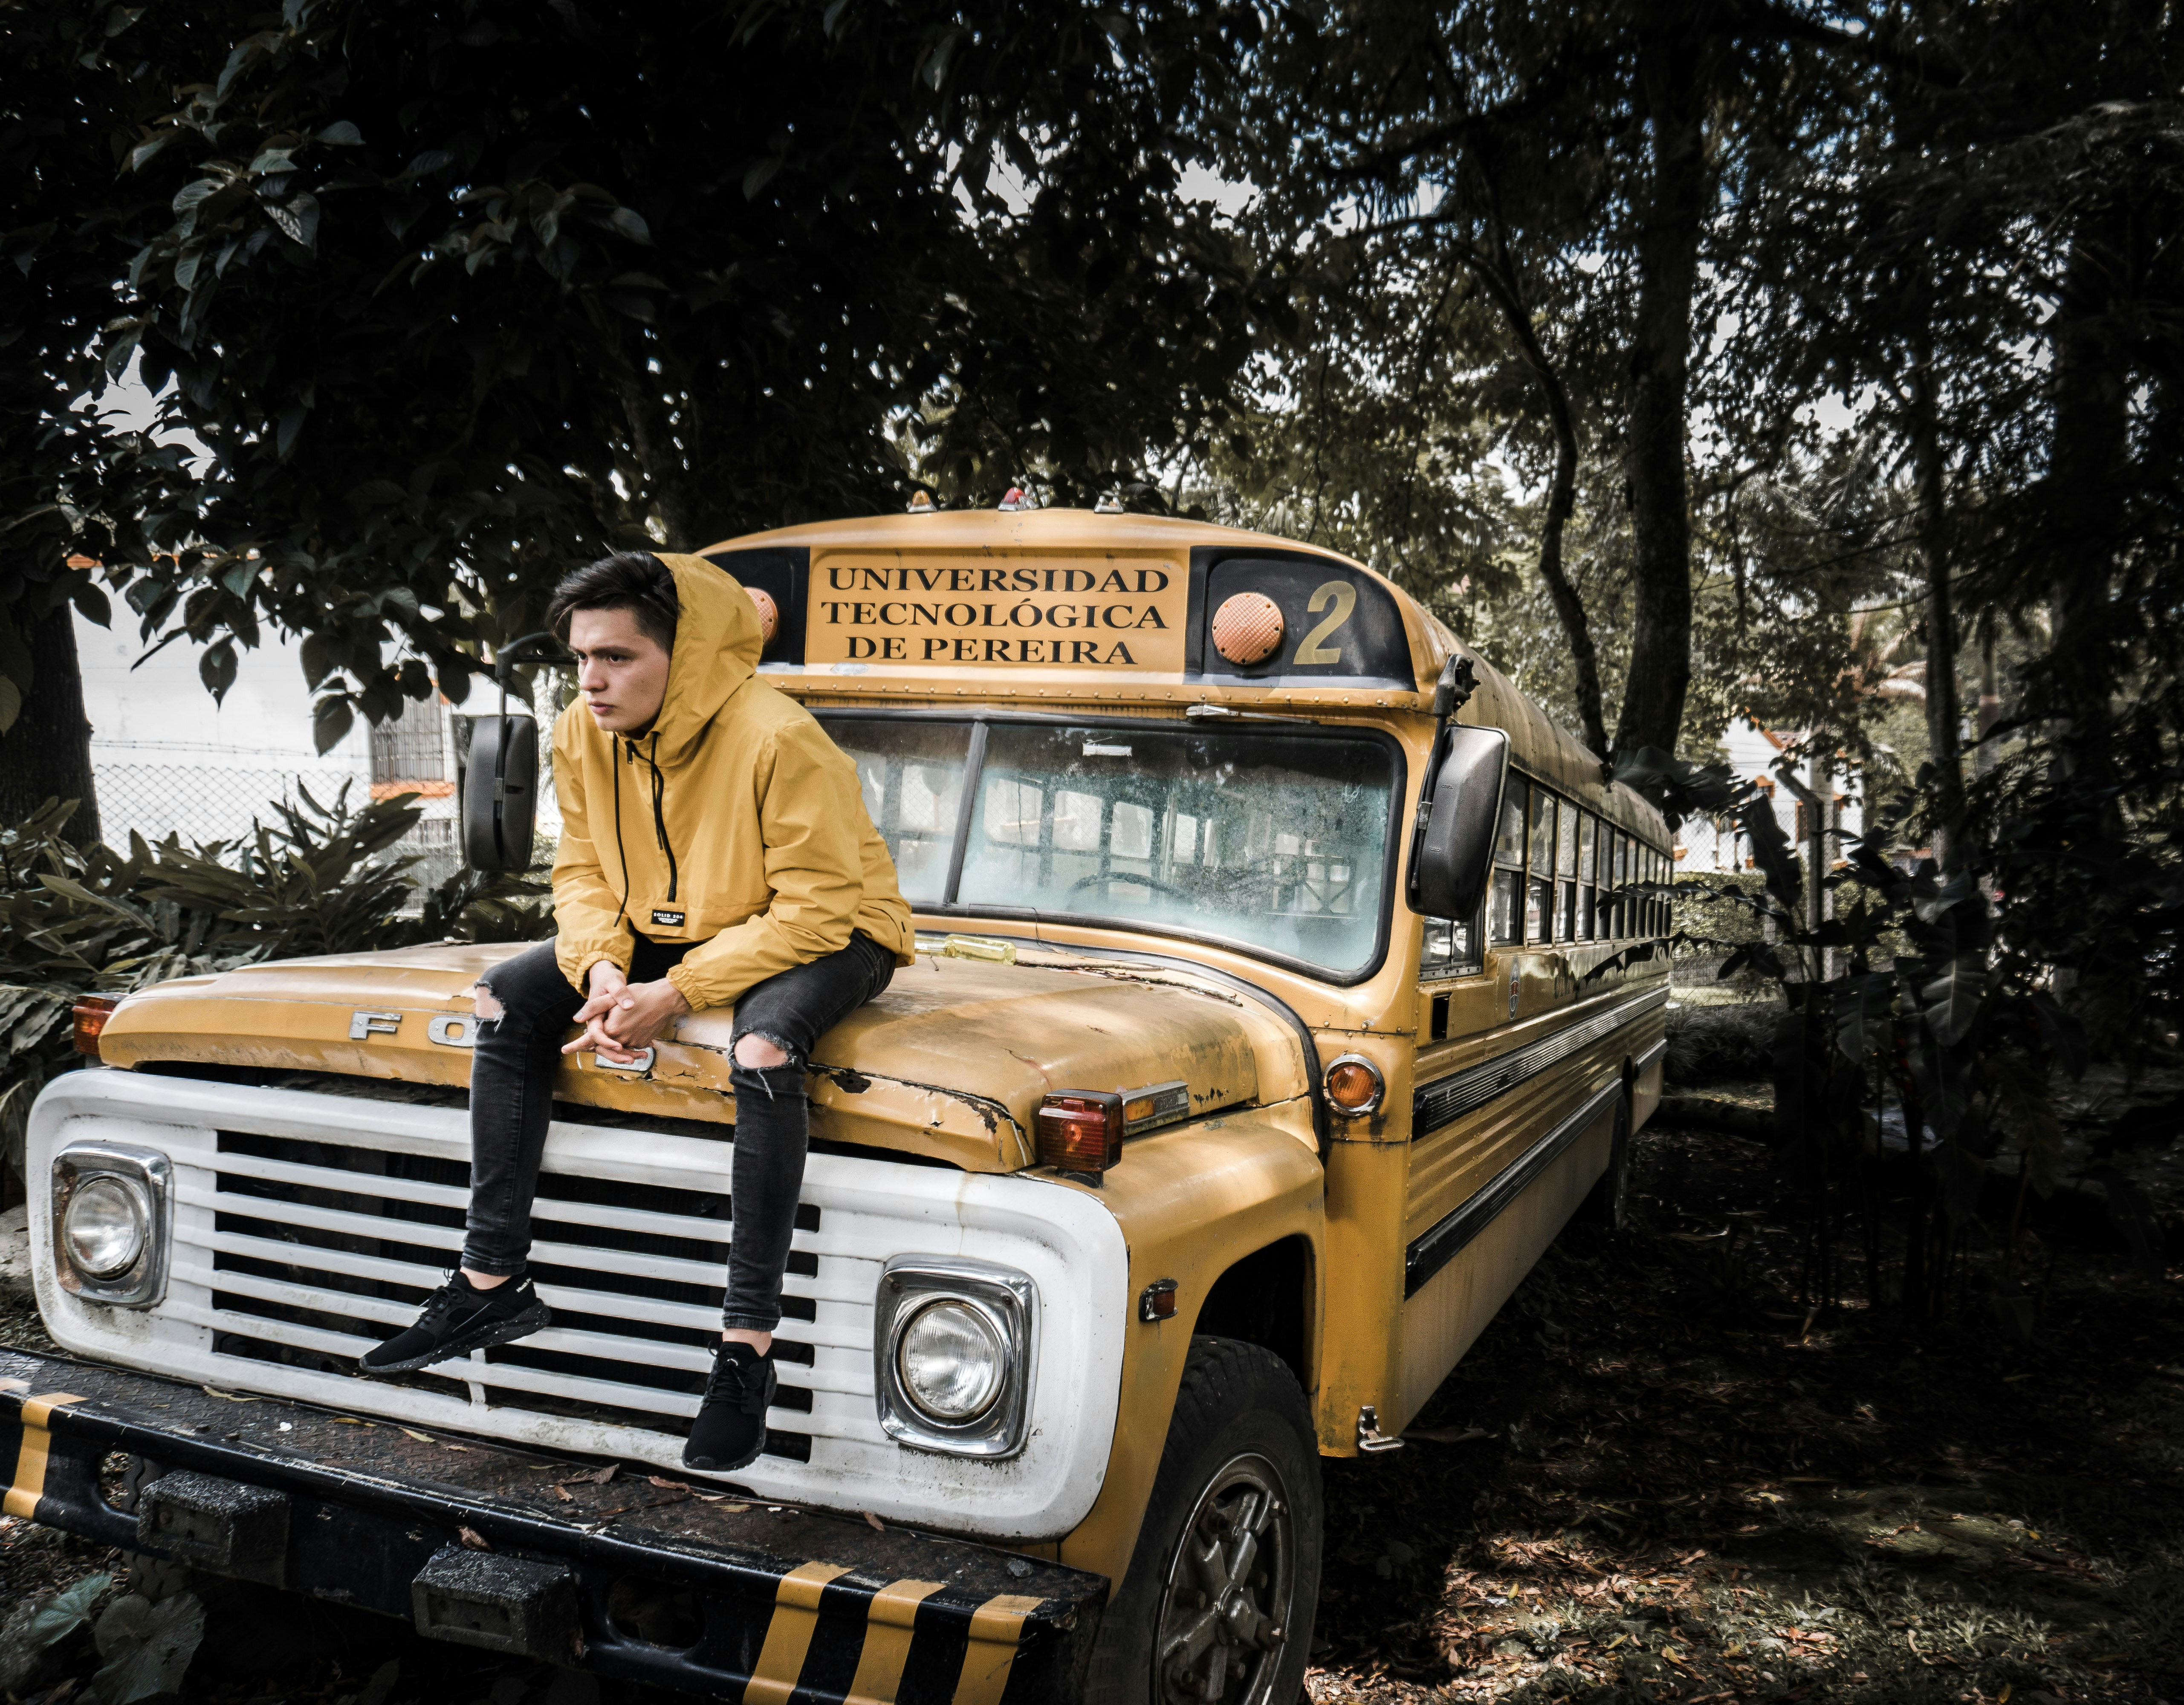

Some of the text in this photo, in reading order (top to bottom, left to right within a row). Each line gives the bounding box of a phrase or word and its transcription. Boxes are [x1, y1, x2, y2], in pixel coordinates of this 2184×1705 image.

[826, 567, 1169, 593] UNIVERSIDAD
[821, 598, 1170, 629] TECNOLÓGICA
[1293, 580, 1357, 665] 2
[845, 636, 1138, 665] DE PEREIRA
